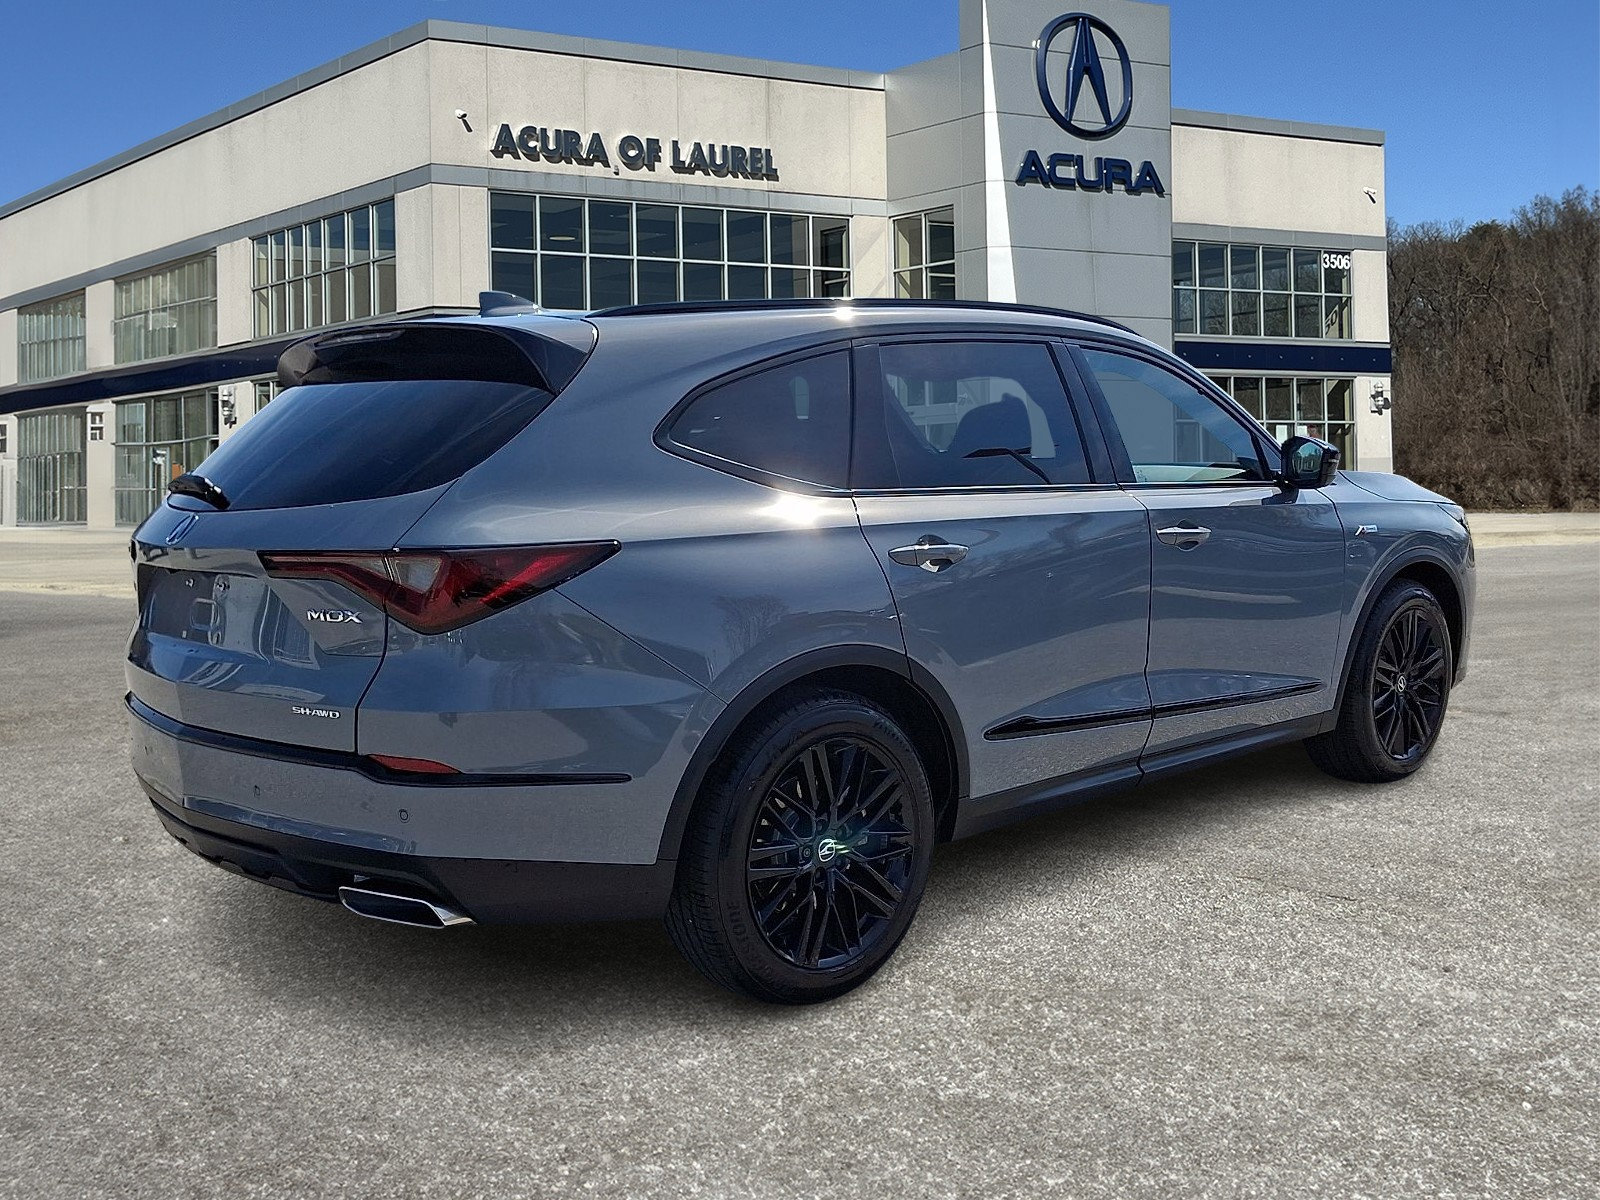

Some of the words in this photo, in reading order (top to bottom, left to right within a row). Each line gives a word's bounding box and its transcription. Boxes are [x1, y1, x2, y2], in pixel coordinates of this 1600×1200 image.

[490, 123, 610, 168] ACURA
[617, 135, 662, 171] OF
[671, 140, 780, 182] LAUREL
[1016, 150, 1166, 197] ACURA
[1322, 253, 1351, 270] 3506
[306, 609, 363, 624] MDX
